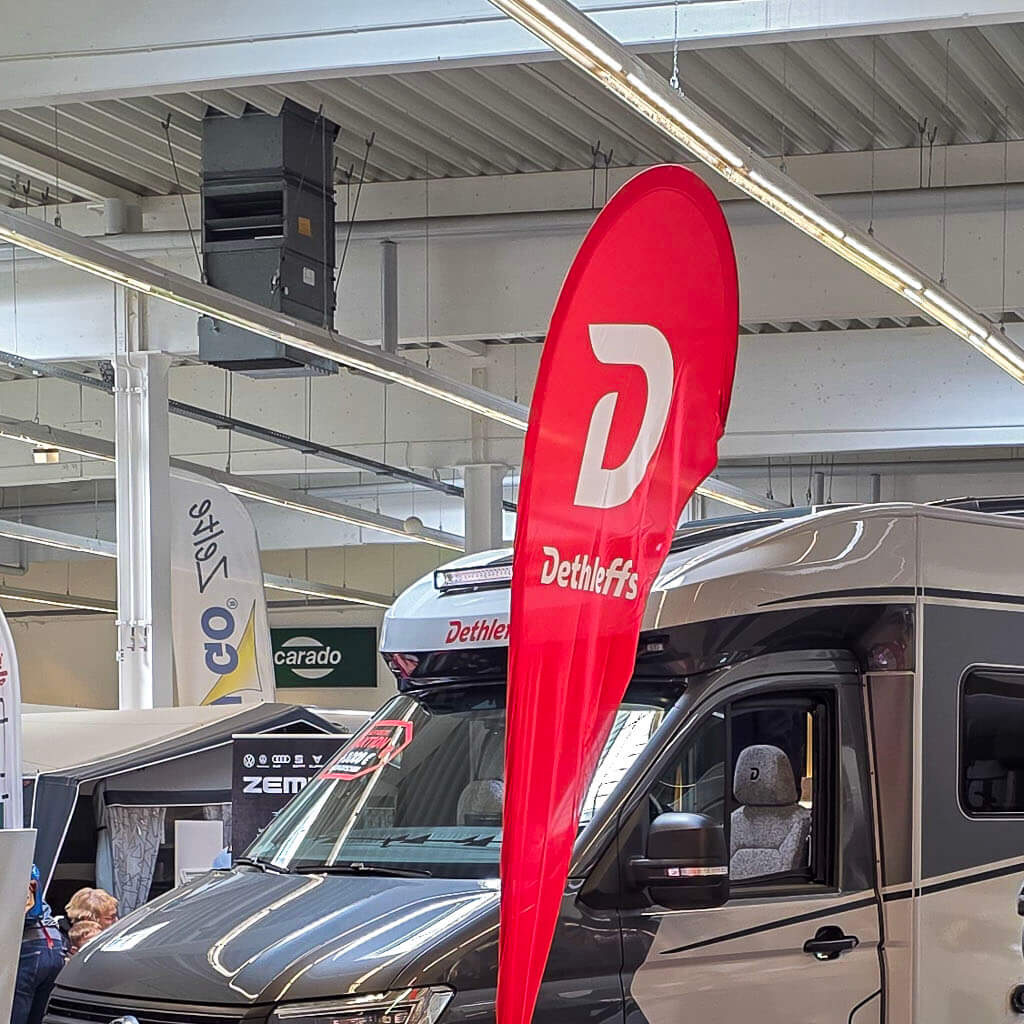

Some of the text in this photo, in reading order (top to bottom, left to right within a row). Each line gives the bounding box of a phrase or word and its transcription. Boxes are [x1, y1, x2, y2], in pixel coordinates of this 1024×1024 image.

[540, 546, 639, 600] Dethleffs
[274, 646, 342, 665] carado
[242, 776, 313, 794] ZEM
